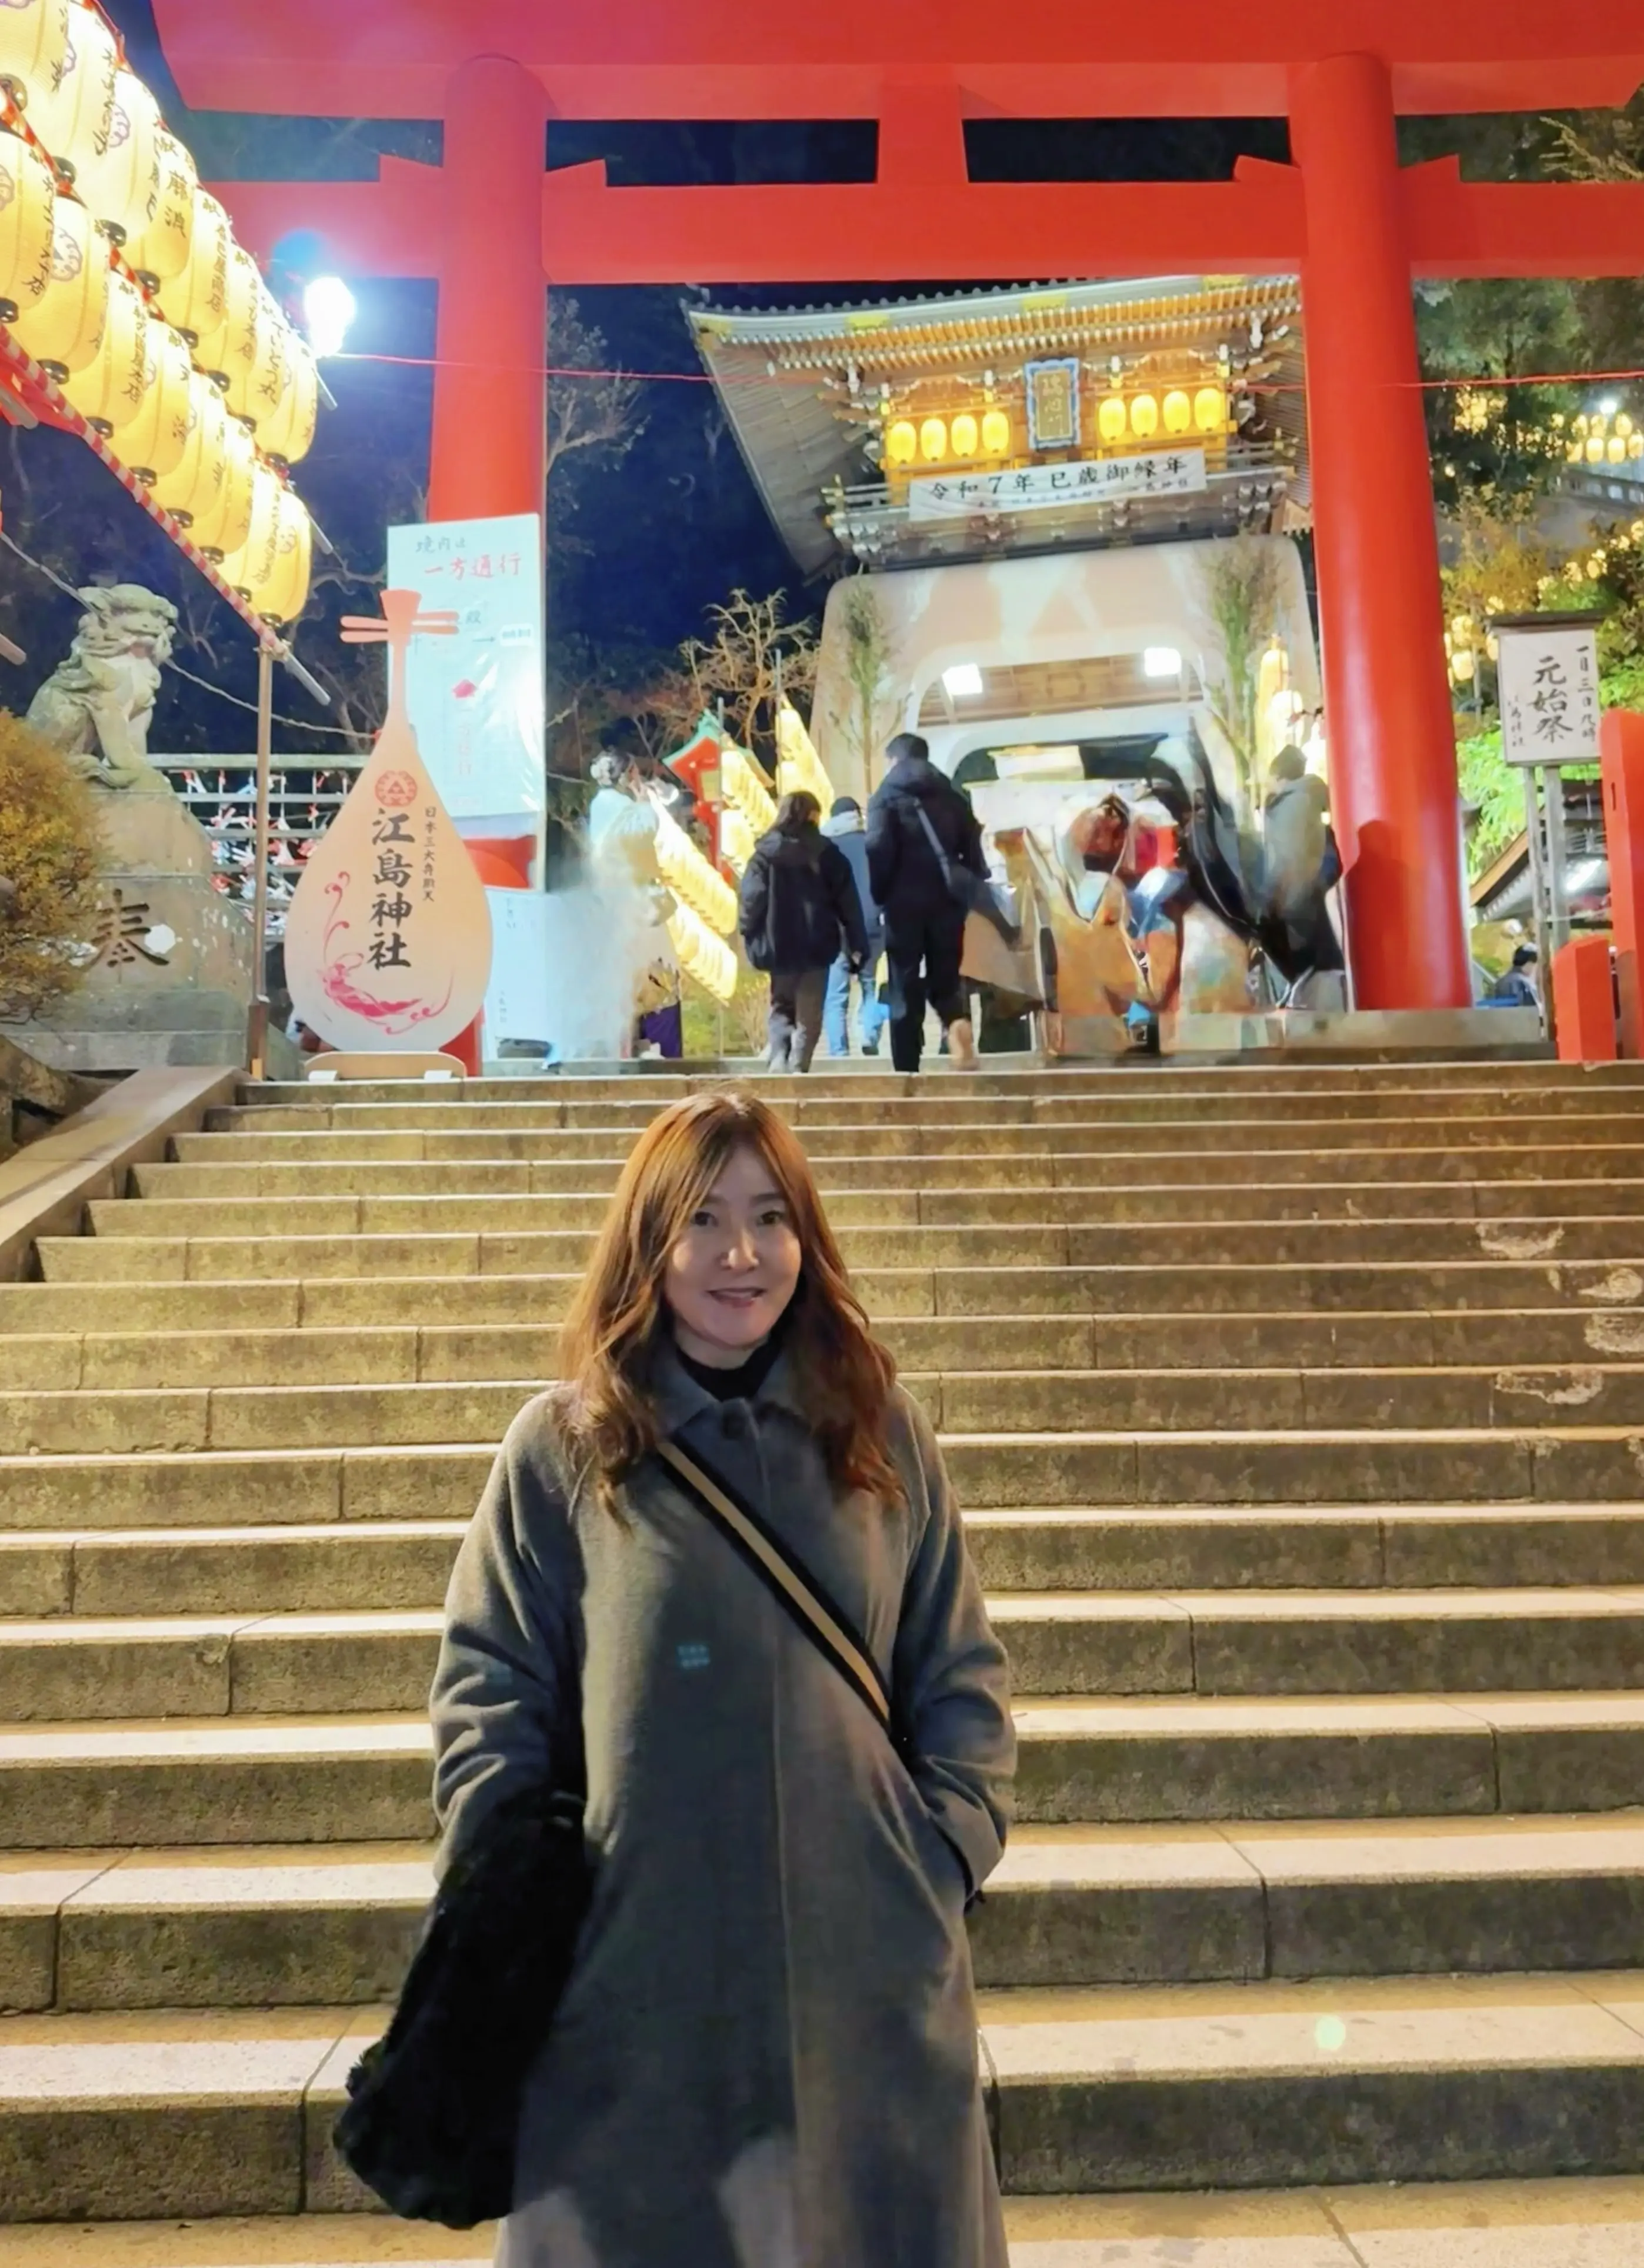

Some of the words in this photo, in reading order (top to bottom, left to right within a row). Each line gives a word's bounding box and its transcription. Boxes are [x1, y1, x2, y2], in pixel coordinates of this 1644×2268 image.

[424, 552, 522, 581] 一方通行
[1527, 655, 1573, 743] 元始祭
[367, 808, 415, 970] 江島神社
[87, 888, 171, 984] 奉
